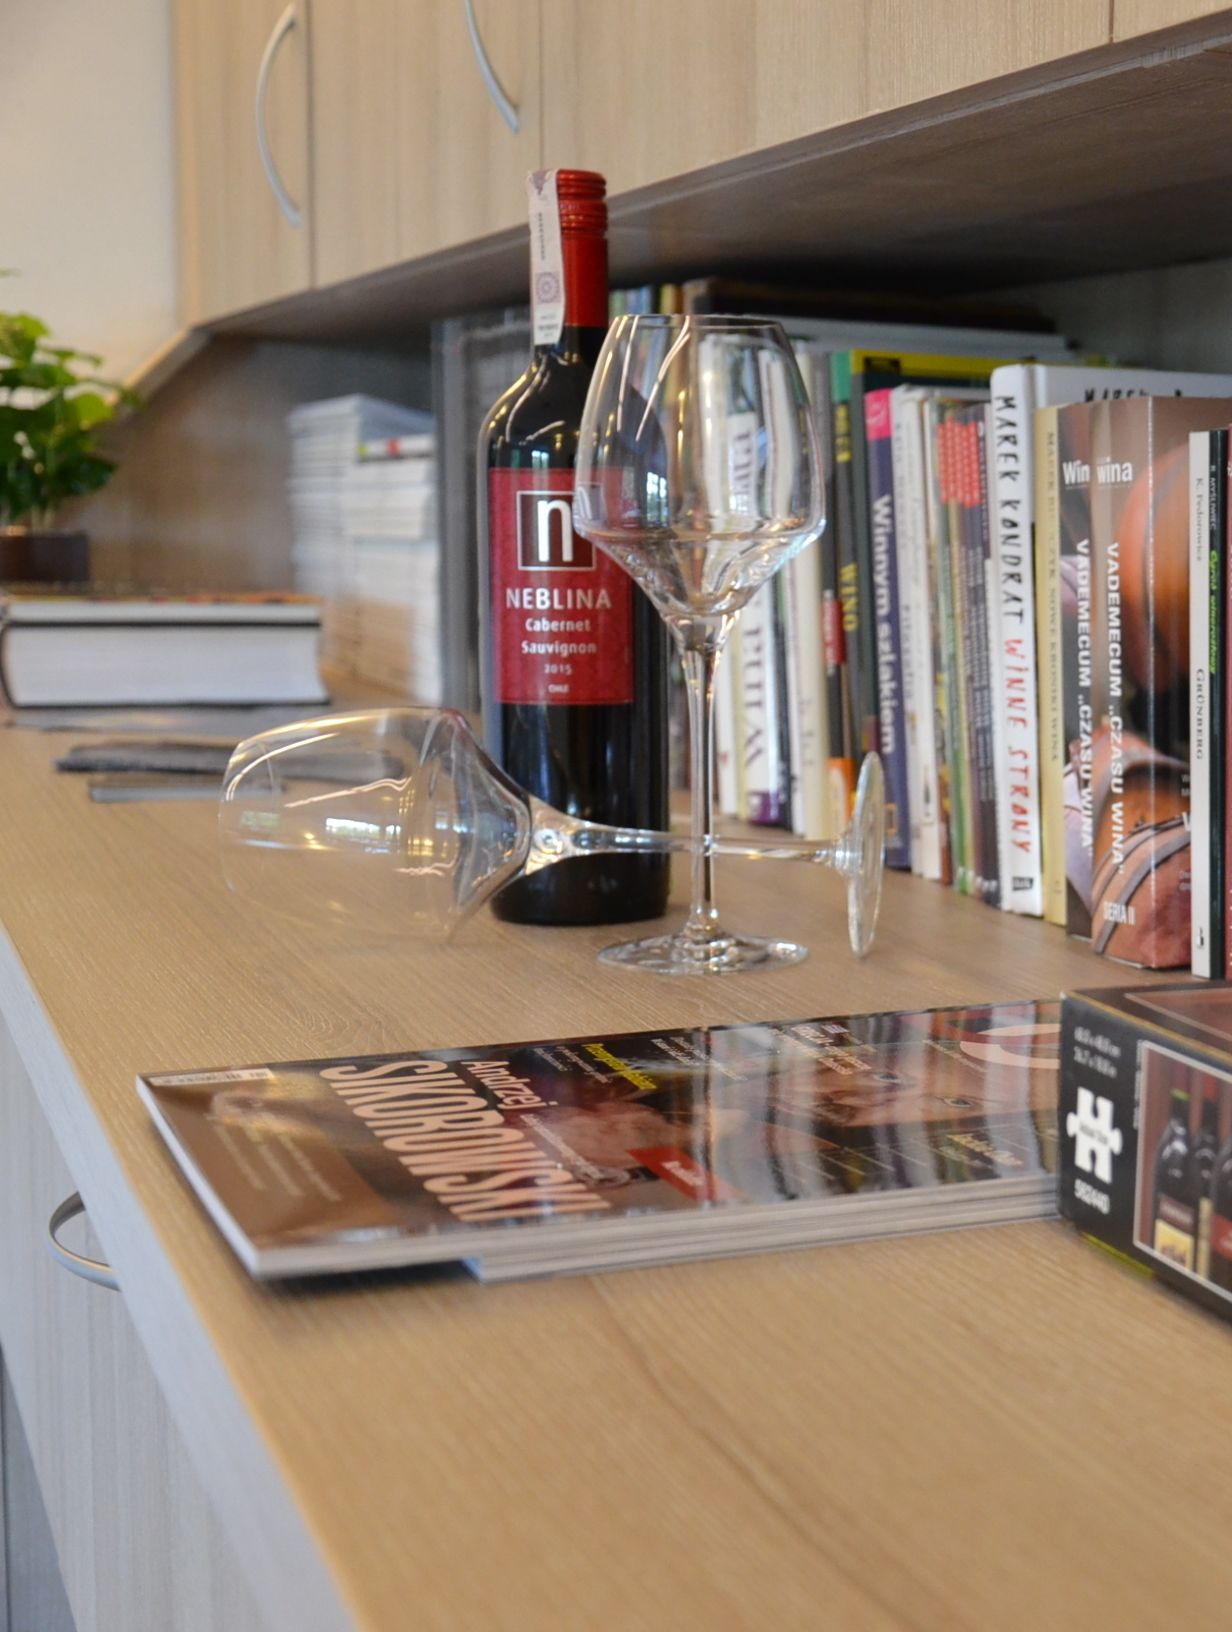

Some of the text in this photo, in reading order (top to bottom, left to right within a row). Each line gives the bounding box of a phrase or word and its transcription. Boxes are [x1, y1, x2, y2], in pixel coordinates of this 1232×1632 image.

[996, 396, 1021, 482] MAREK
[506, 587, 613, 610] NEBLINA
[1000, 500, 1024, 623] KONDRAT
[521, 640, 598, 658] Sauvignon
[525, 617, 592, 632] Cabernet
[872, 494, 899, 755] Winnym szlakiem
[1075, 538, 1092, 688] VADEMECUM
[1105, 543, 1123, 698] VADEMECUM
[544, 664, 573, 675] 2015
[1004, 638, 1029, 728] WINNE
[1008, 746, 1031, 853] STRONY
[459, 1060, 559, 1110] Andrzej
[318, 1059, 613, 1223] SIKOROWSKI
